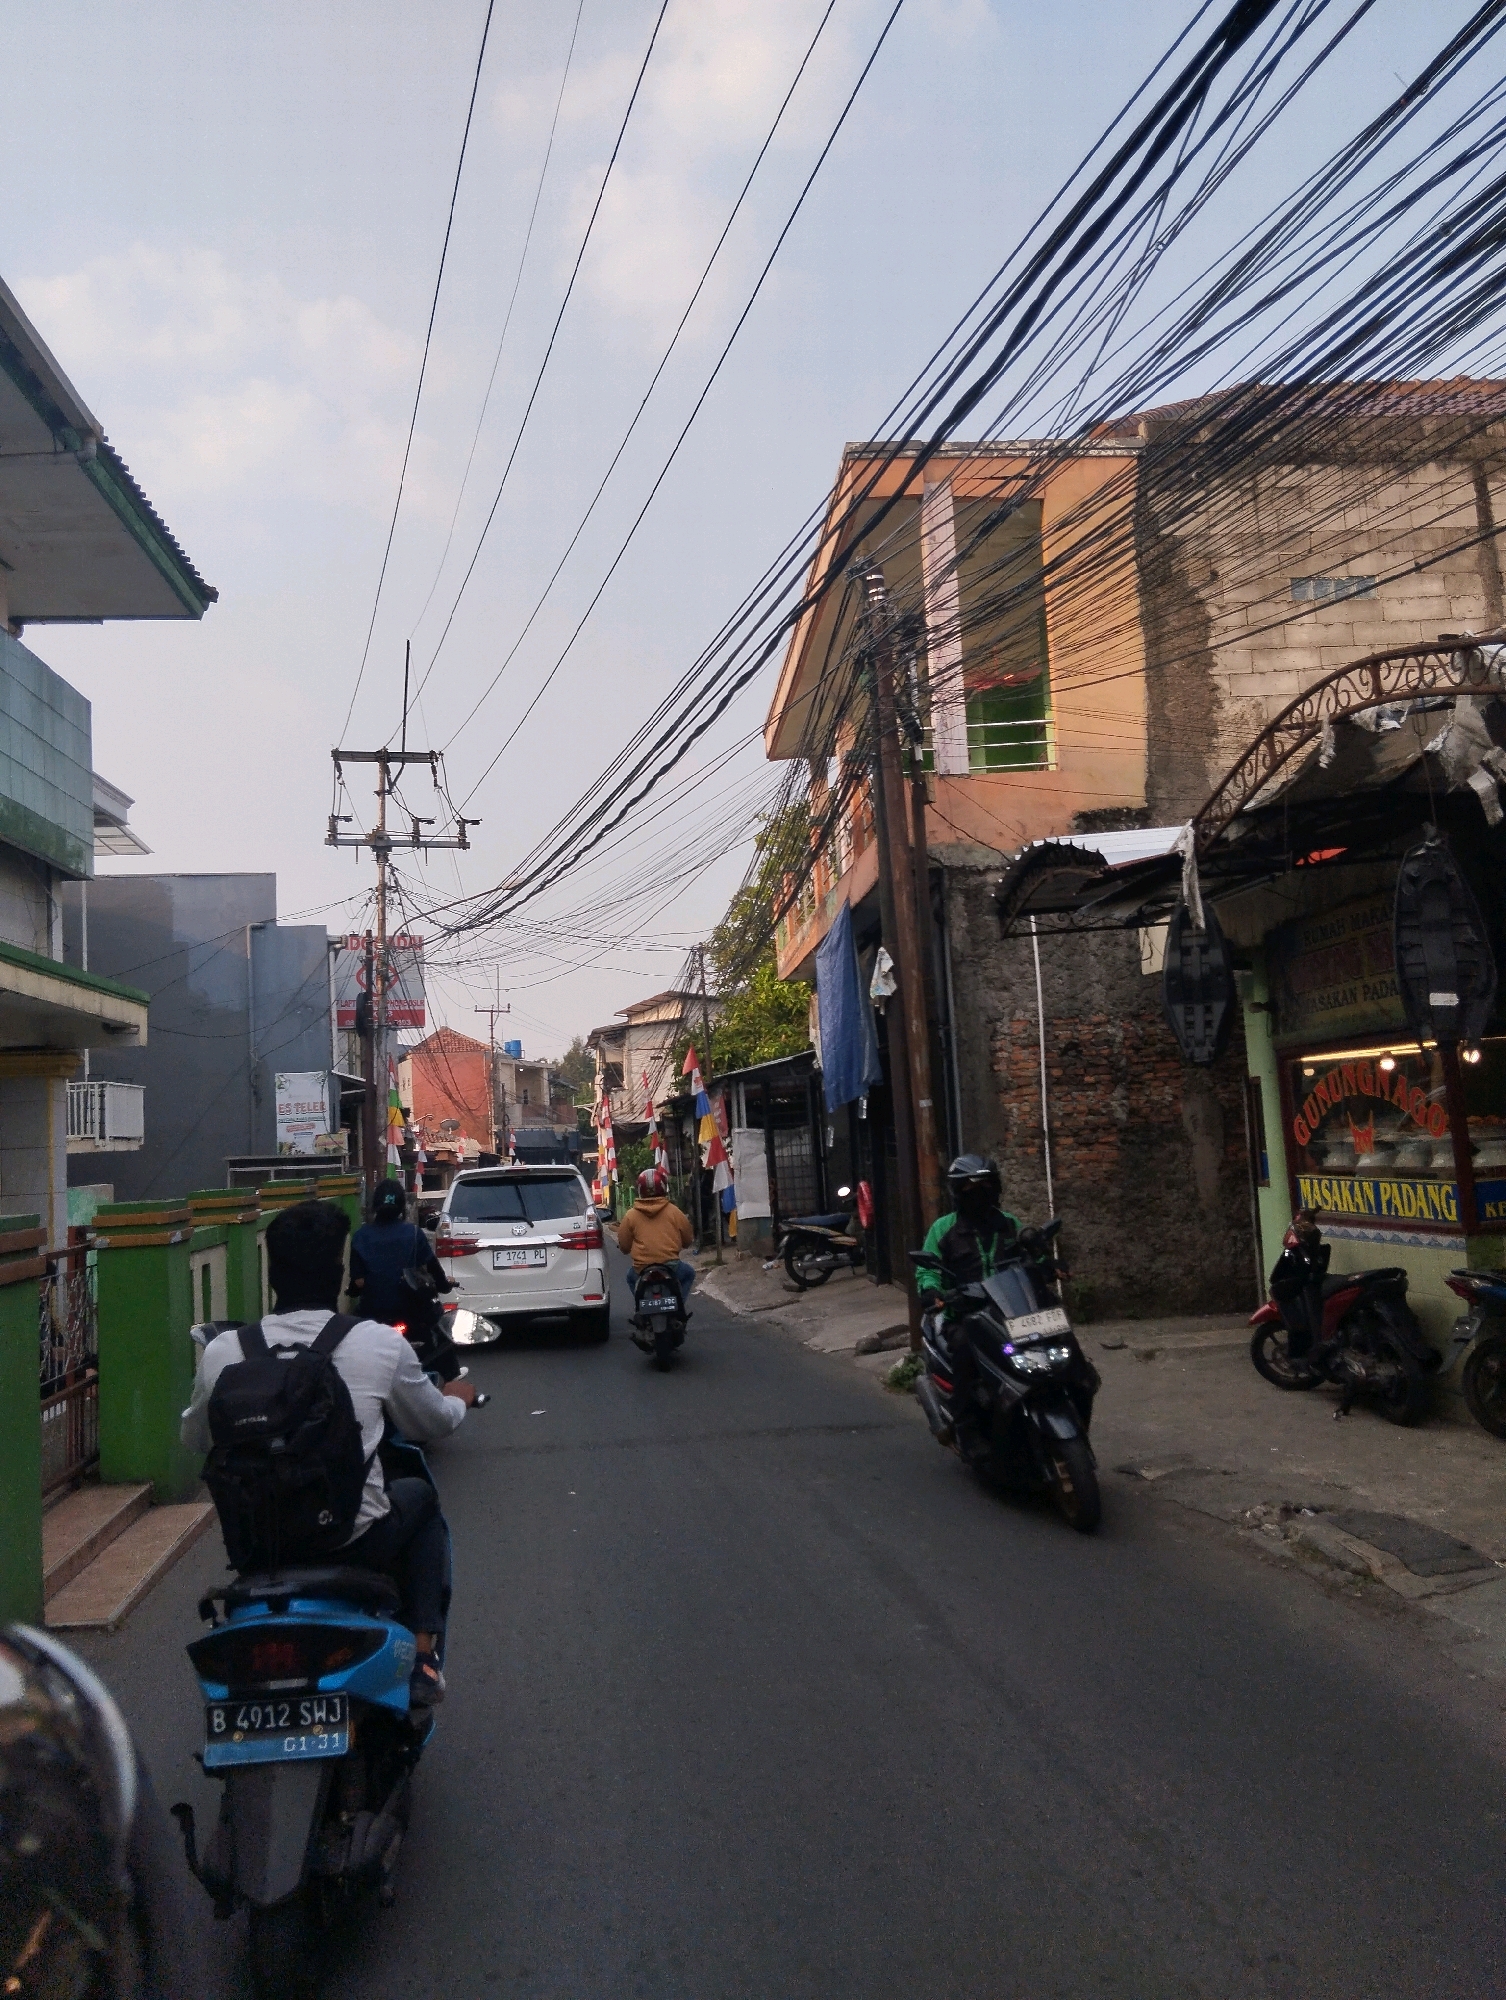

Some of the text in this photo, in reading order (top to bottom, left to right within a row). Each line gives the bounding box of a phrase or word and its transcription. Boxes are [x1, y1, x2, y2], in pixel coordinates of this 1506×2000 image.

[1361, 978, 1400, 1002] PADA
[1300, 1178, 1458, 1222] MASAKAN PADANG
[212, 1698, 341, 1734] B 4912 SWJ
